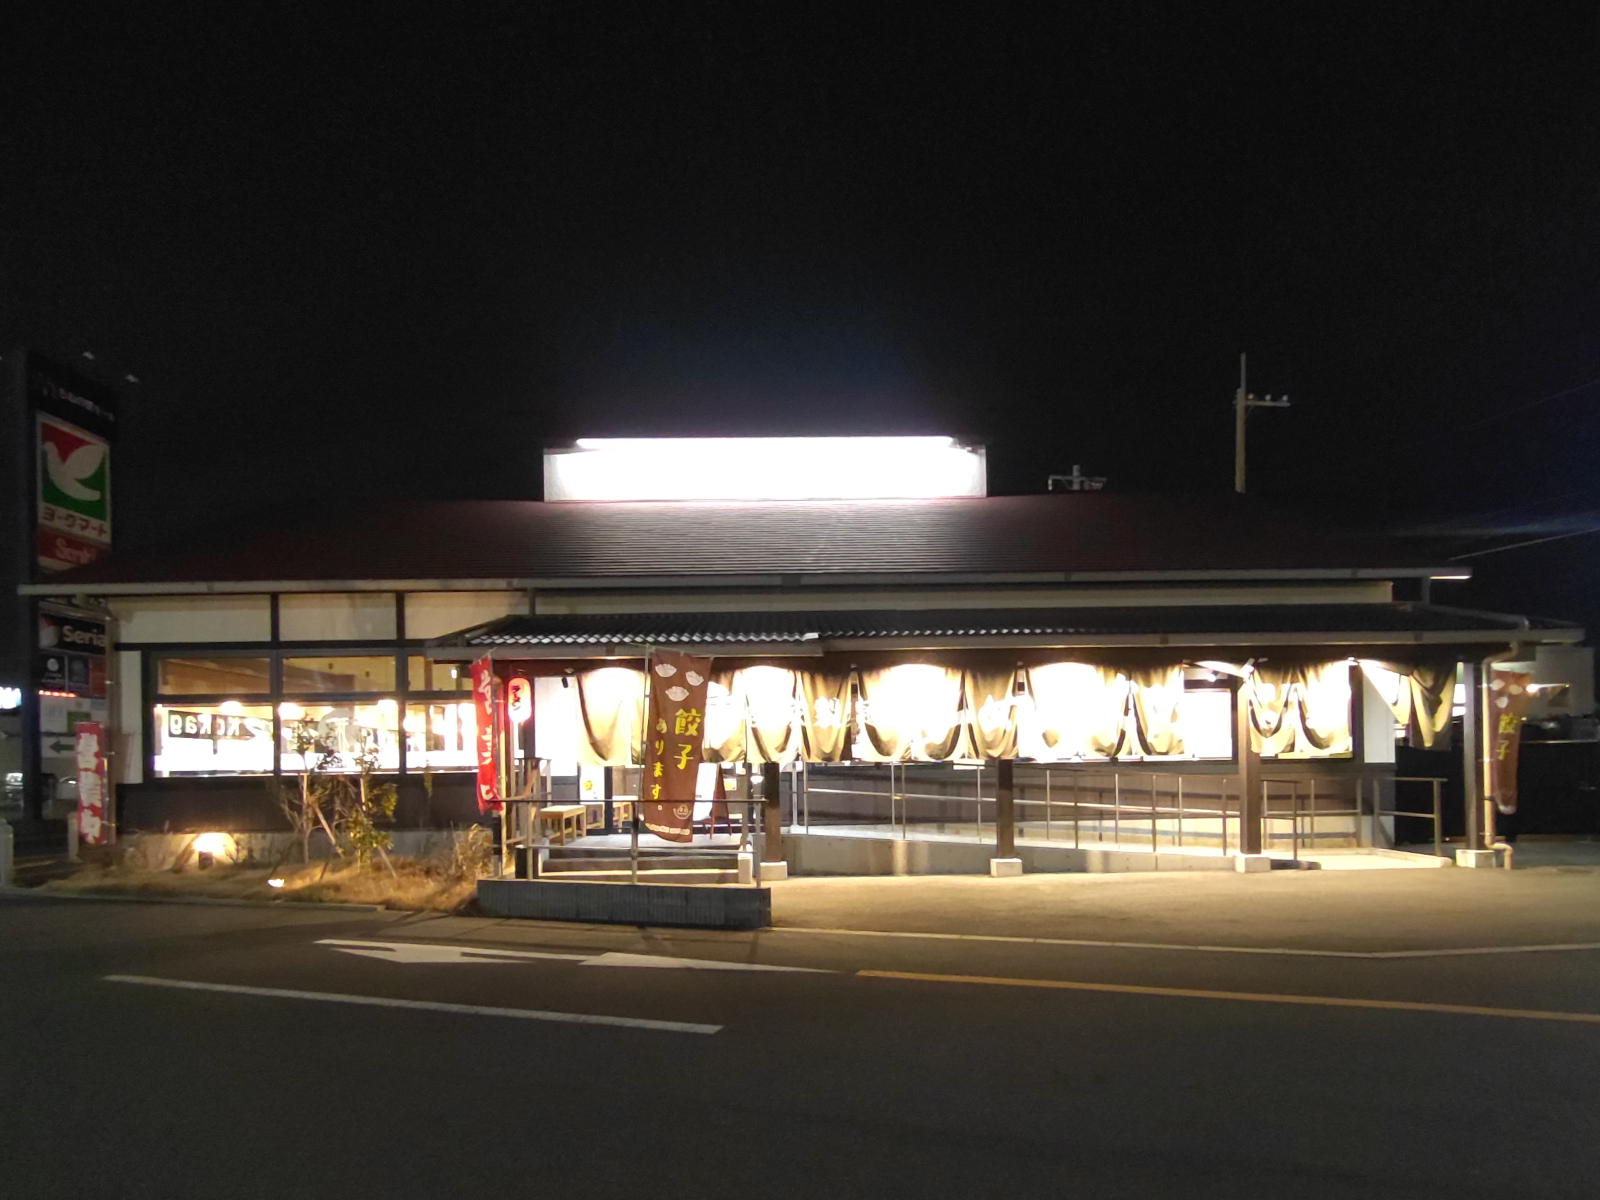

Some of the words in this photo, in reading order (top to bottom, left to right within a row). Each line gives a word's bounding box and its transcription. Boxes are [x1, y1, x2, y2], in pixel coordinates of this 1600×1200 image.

[43, 506, 108, 537] ヨークマート
[62, 624, 105, 646] Seria
[674, 708, 701, 770] 餃子
